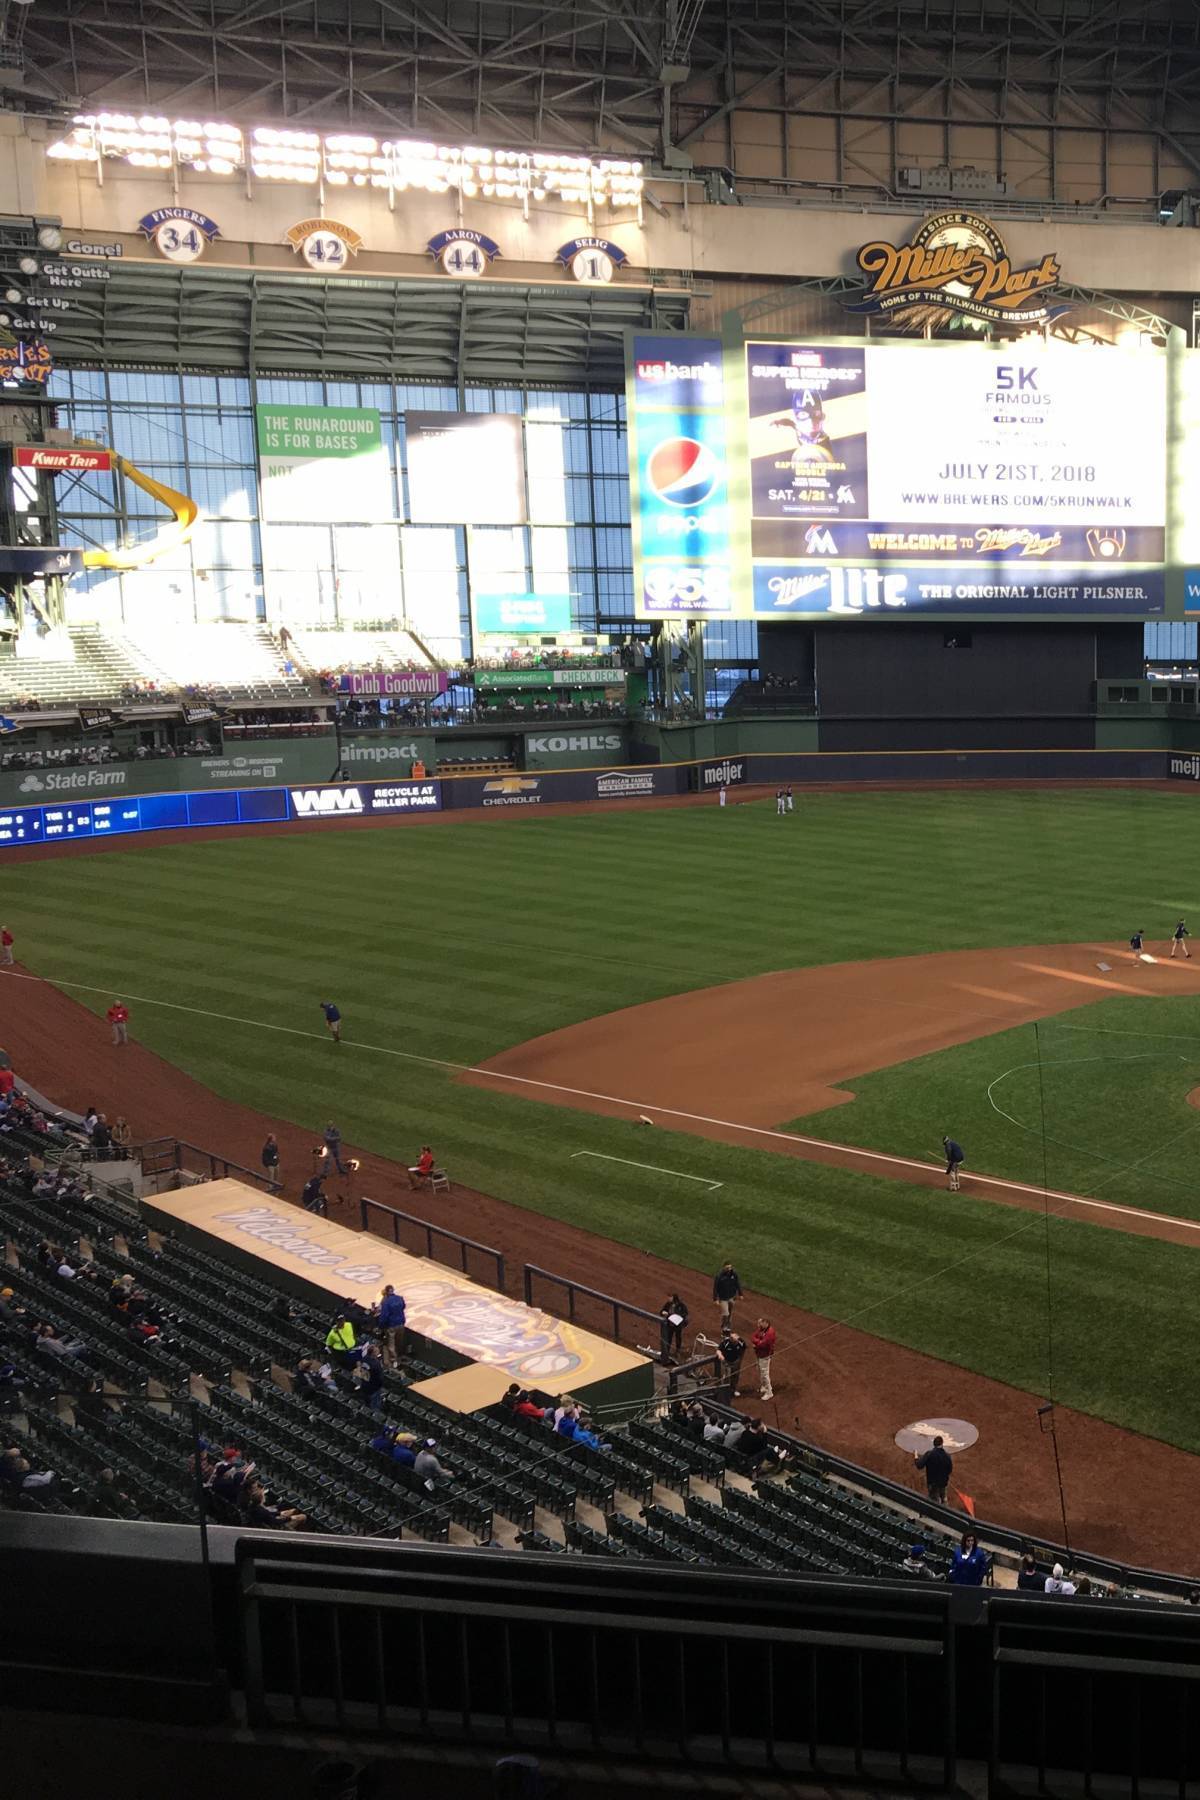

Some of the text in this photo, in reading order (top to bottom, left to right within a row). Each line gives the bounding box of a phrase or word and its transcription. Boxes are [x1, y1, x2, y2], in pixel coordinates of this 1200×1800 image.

[151, 208, 207, 226] FINGERS
[928, 215, 990, 234] SINCE 2001
[163, 228, 201, 253] 34
[444, 230, 482, 243] AARON
[575, 238, 608, 250] SELIG
[67, 240, 122, 257] Gone!
[308, 239, 343, 263] 42
[448, 248, 480, 273] 44
[586, 257, 600, 280] 1
[43, 264, 110, 279] Get Outta
[859, 242, 1060, 303] Miller Park
[49, 277, 82, 288] Here
[26, 297, 69, 310] Get Up
[880, 292, 1047, 321] HOME OF THE MILWAUKEE BREWERS
[13, 318, 57, 332] Get Up
[996, 366, 1038, 390] 5K
[985, 393, 1051, 405] FAMOUS
[264, 416, 374, 433] THE RUNAROUND
[266, 434, 358, 449] IS FOR BASES
[939, 463, 989, 481] JULY
[1051, 466, 1095, 482] 2018
[867, 533, 957, 551] WELCOME
[960, 537, 974, 548] TO
[768, 575, 830, 606] Miller
[919, 584, 951, 598] THE
[956, 585, 1029, 599] ORIGINAL
[1032, 587, 1078, 599] LIGHT
[352, 673, 439, 694] Club Goodwill
[561, 671, 618, 682] CHECK DECK
[528, 735, 621, 752] KOHL'S
[598, 777, 653, 785] AMERICAN FAMILY
[704, 761, 743, 785] meijer
[374, 786, 433, 798] RECYCLE AT
[483, 795, 542, 806] CHEVROLET
[372, 796, 436, 808] MILLER PARK
[211, 1206, 384, 1285] Welcome to
